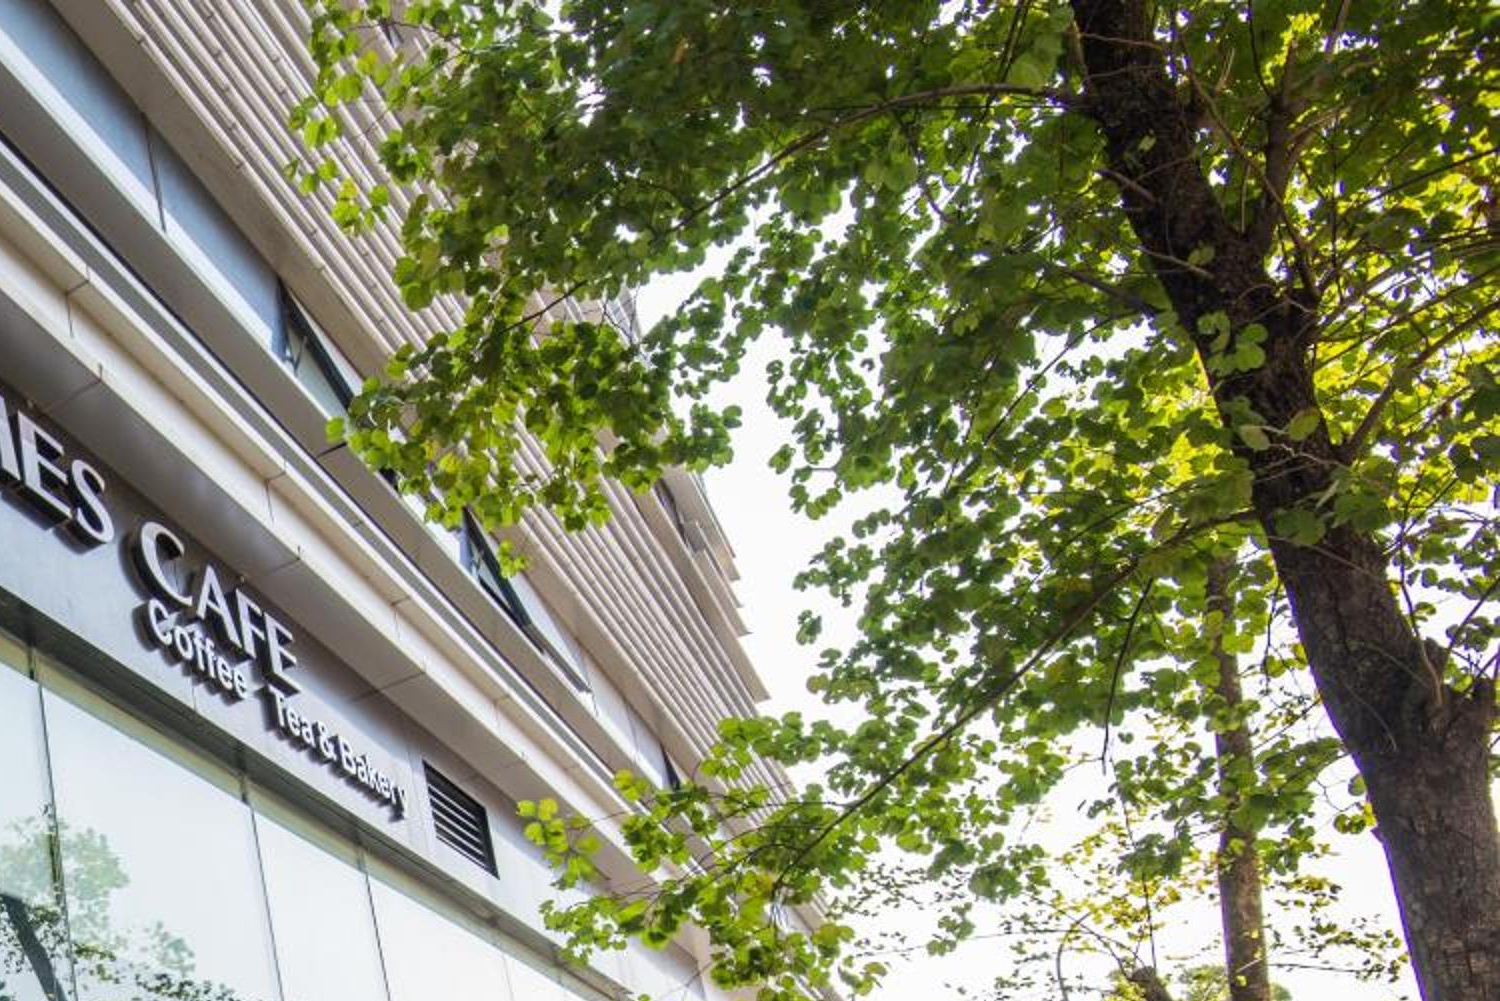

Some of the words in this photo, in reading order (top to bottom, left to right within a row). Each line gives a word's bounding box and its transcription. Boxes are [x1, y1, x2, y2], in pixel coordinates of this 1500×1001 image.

[133, 520, 301, 692] CAFE
[145, 597, 249, 701] Coffee
[266, 684, 316, 746] Tea
[317, 721, 337, 762] &
[337, 735, 408, 815] Bakery
